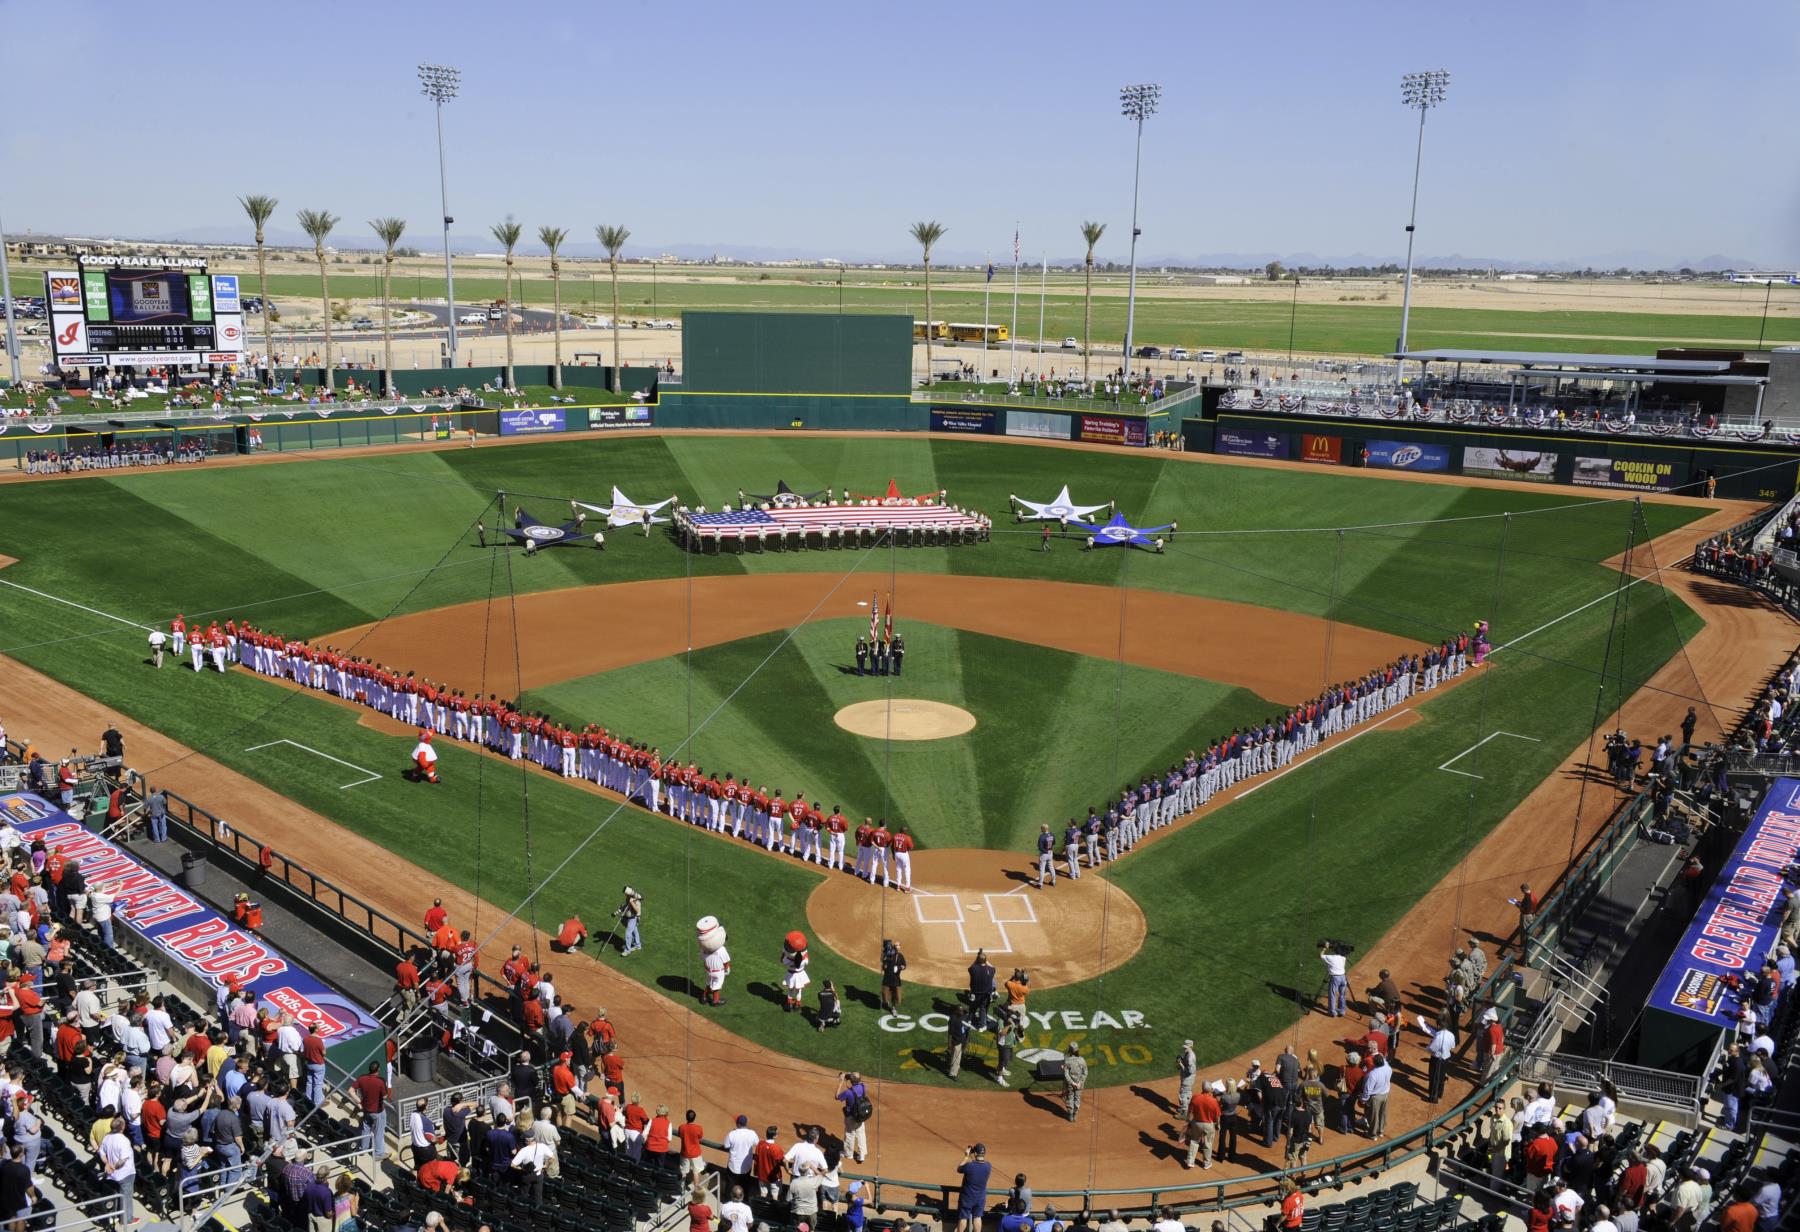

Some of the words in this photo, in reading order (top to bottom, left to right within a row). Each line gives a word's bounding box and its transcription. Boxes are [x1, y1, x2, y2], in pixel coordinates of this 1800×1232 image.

[80, 255, 150, 266] GOODYEAR
[150, 257, 208, 267] BALLPARK
[1394, 451, 1419, 465] Lite
[1613, 460, 1654, 474] COOKIN
[1656, 464, 1671, 475] ON
[1624, 472, 1658, 484] WOOD
[1573, 479, 1670, 492] www.cookinonwood.com
[21, 823, 205, 930] CINCINNATI
[154, 917, 288, 988] REDS
[1691, 866, 1784, 969] CLEVELAND
[878, 1010, 1152, 1033] GOYEAR
